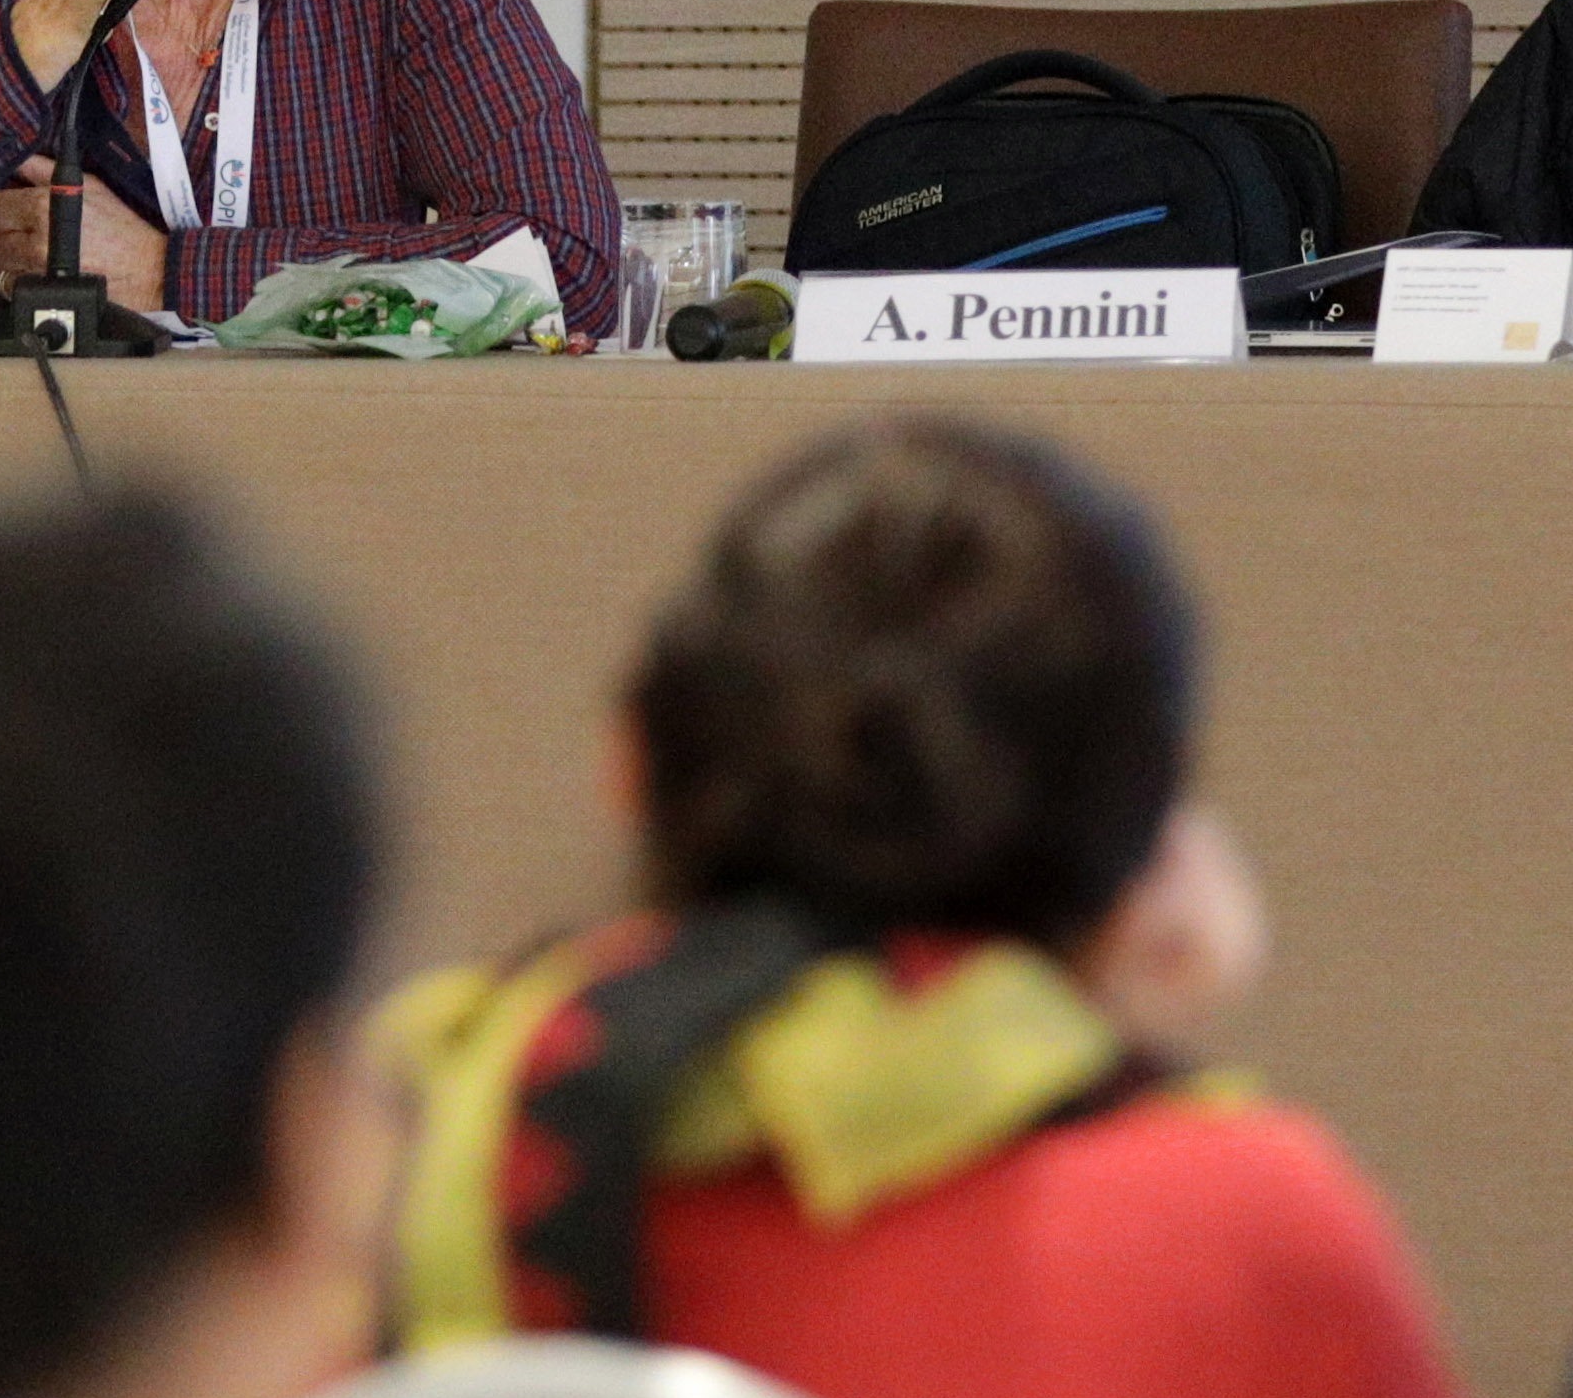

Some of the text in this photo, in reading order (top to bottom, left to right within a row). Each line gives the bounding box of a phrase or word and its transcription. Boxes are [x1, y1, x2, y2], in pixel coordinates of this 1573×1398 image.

[217, 188, 237, 225] OPI
[857, 194, 943, 230] TOURISTER
[858, 184, 943, 220] AMERICAN
[861, 289, 1169, 342] A. Pennini
